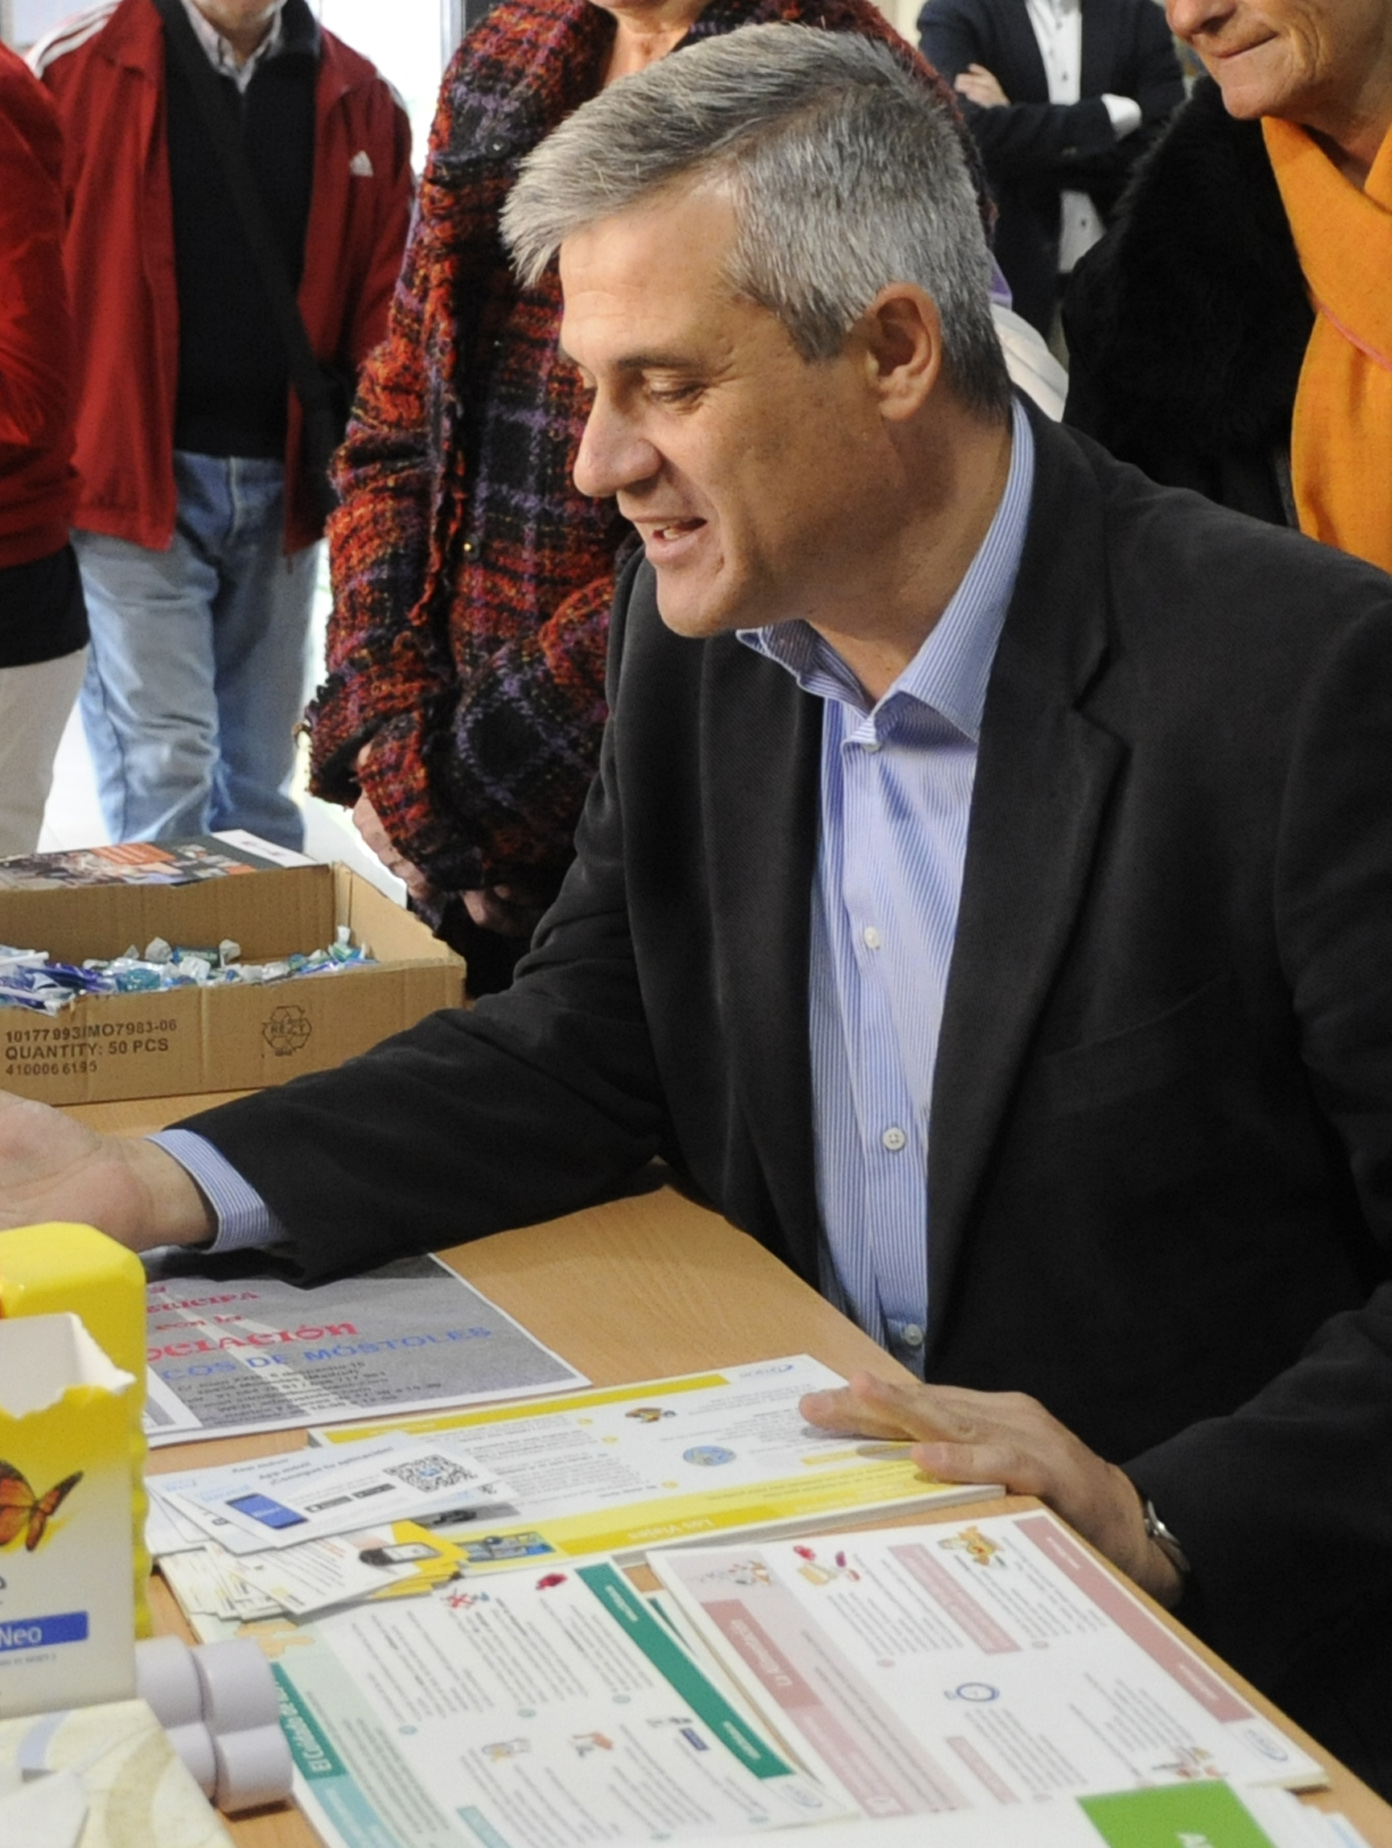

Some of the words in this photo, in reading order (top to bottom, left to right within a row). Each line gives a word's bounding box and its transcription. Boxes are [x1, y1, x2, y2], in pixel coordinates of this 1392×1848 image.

[5, 1041, 104, 1061] QUANTITY:
[107, 1041, 128, 1055] 50
[133, 1037, 170, 1052] PCS
[303, 1326, 493, 1362] MÓSTOLES
